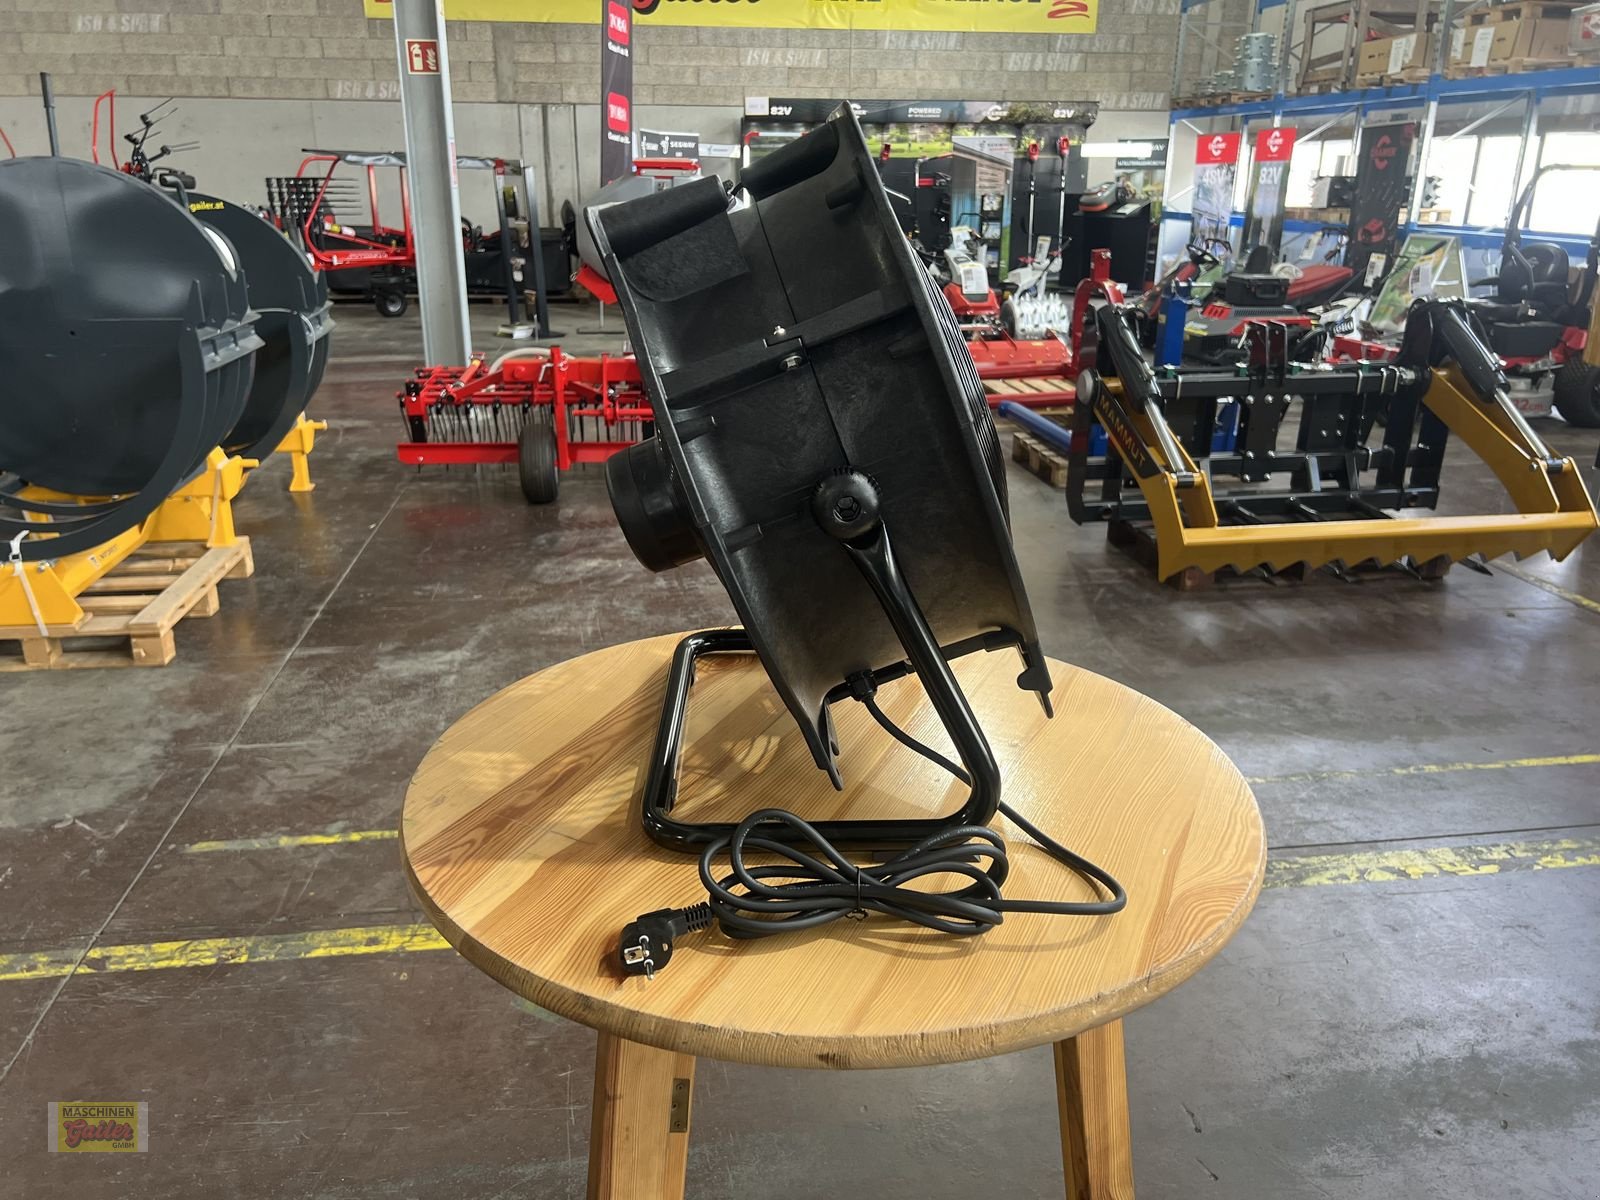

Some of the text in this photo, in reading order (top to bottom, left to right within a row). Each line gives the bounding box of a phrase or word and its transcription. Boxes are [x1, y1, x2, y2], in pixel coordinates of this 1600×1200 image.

[771, 106, 793, 116] 82V
[1053, 109, 1076, 119] 82V
[1202, 168, 1226, 186] 48V
[1259, 166, 1282, 185] 82V
[1101, 394, 1146, 467] MAMMUT
